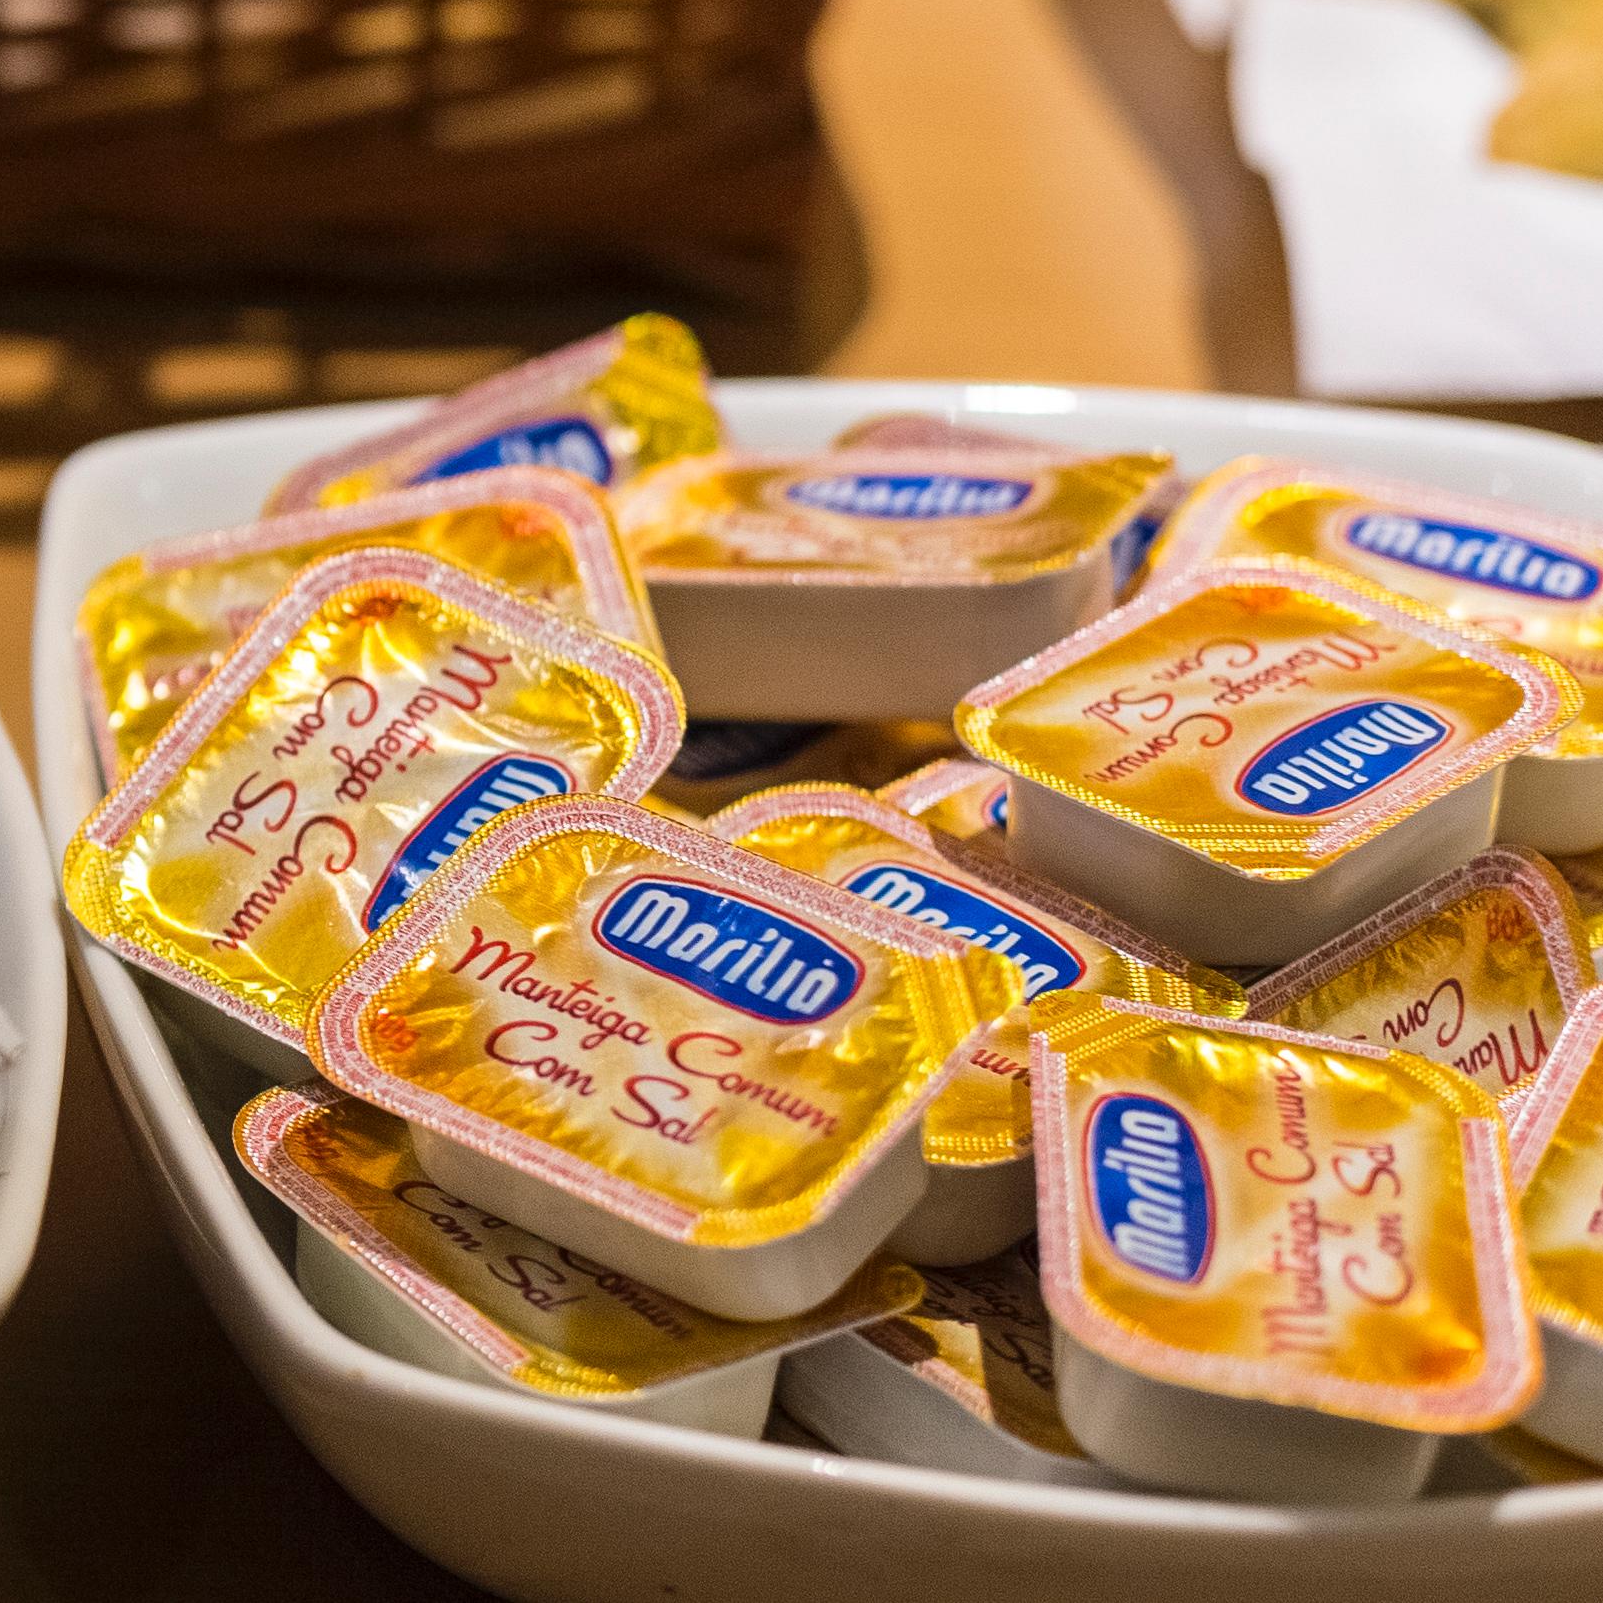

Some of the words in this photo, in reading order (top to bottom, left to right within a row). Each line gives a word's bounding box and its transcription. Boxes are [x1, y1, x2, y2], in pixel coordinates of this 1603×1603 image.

[1353, 514, 1592, 598] Marília
[1153, 636, 1260, 683] Com
[1211, 631, 1394, 709] Manteiga
[271, 675, 380, 761] Com
[334, 642, 513, 805] Manteiga
[1080, 685, 1175, 736] Sal
[1091, 712, 1233, 786] Comum
[1250, 702, 1446, 807] Marília
[205, 772, 298, 856] Sal
[212, 814, 358, 953] Comum
[609, 888, 840, 1015] Marília
[449, 925, 653, 1051] Manteiga
[667, 1031, 840, 1138] Comum
[1383, 979, 1466, 1046] Com
[484, 1020, 596, 1097] Com
[611, 1075, 720, 1145] Sal
[1114, 1109, 1192, 1280] Marília
[1262, 1199, 1337, 1355] Manteiga
[1343, 1213, 1415, 1306] Com
